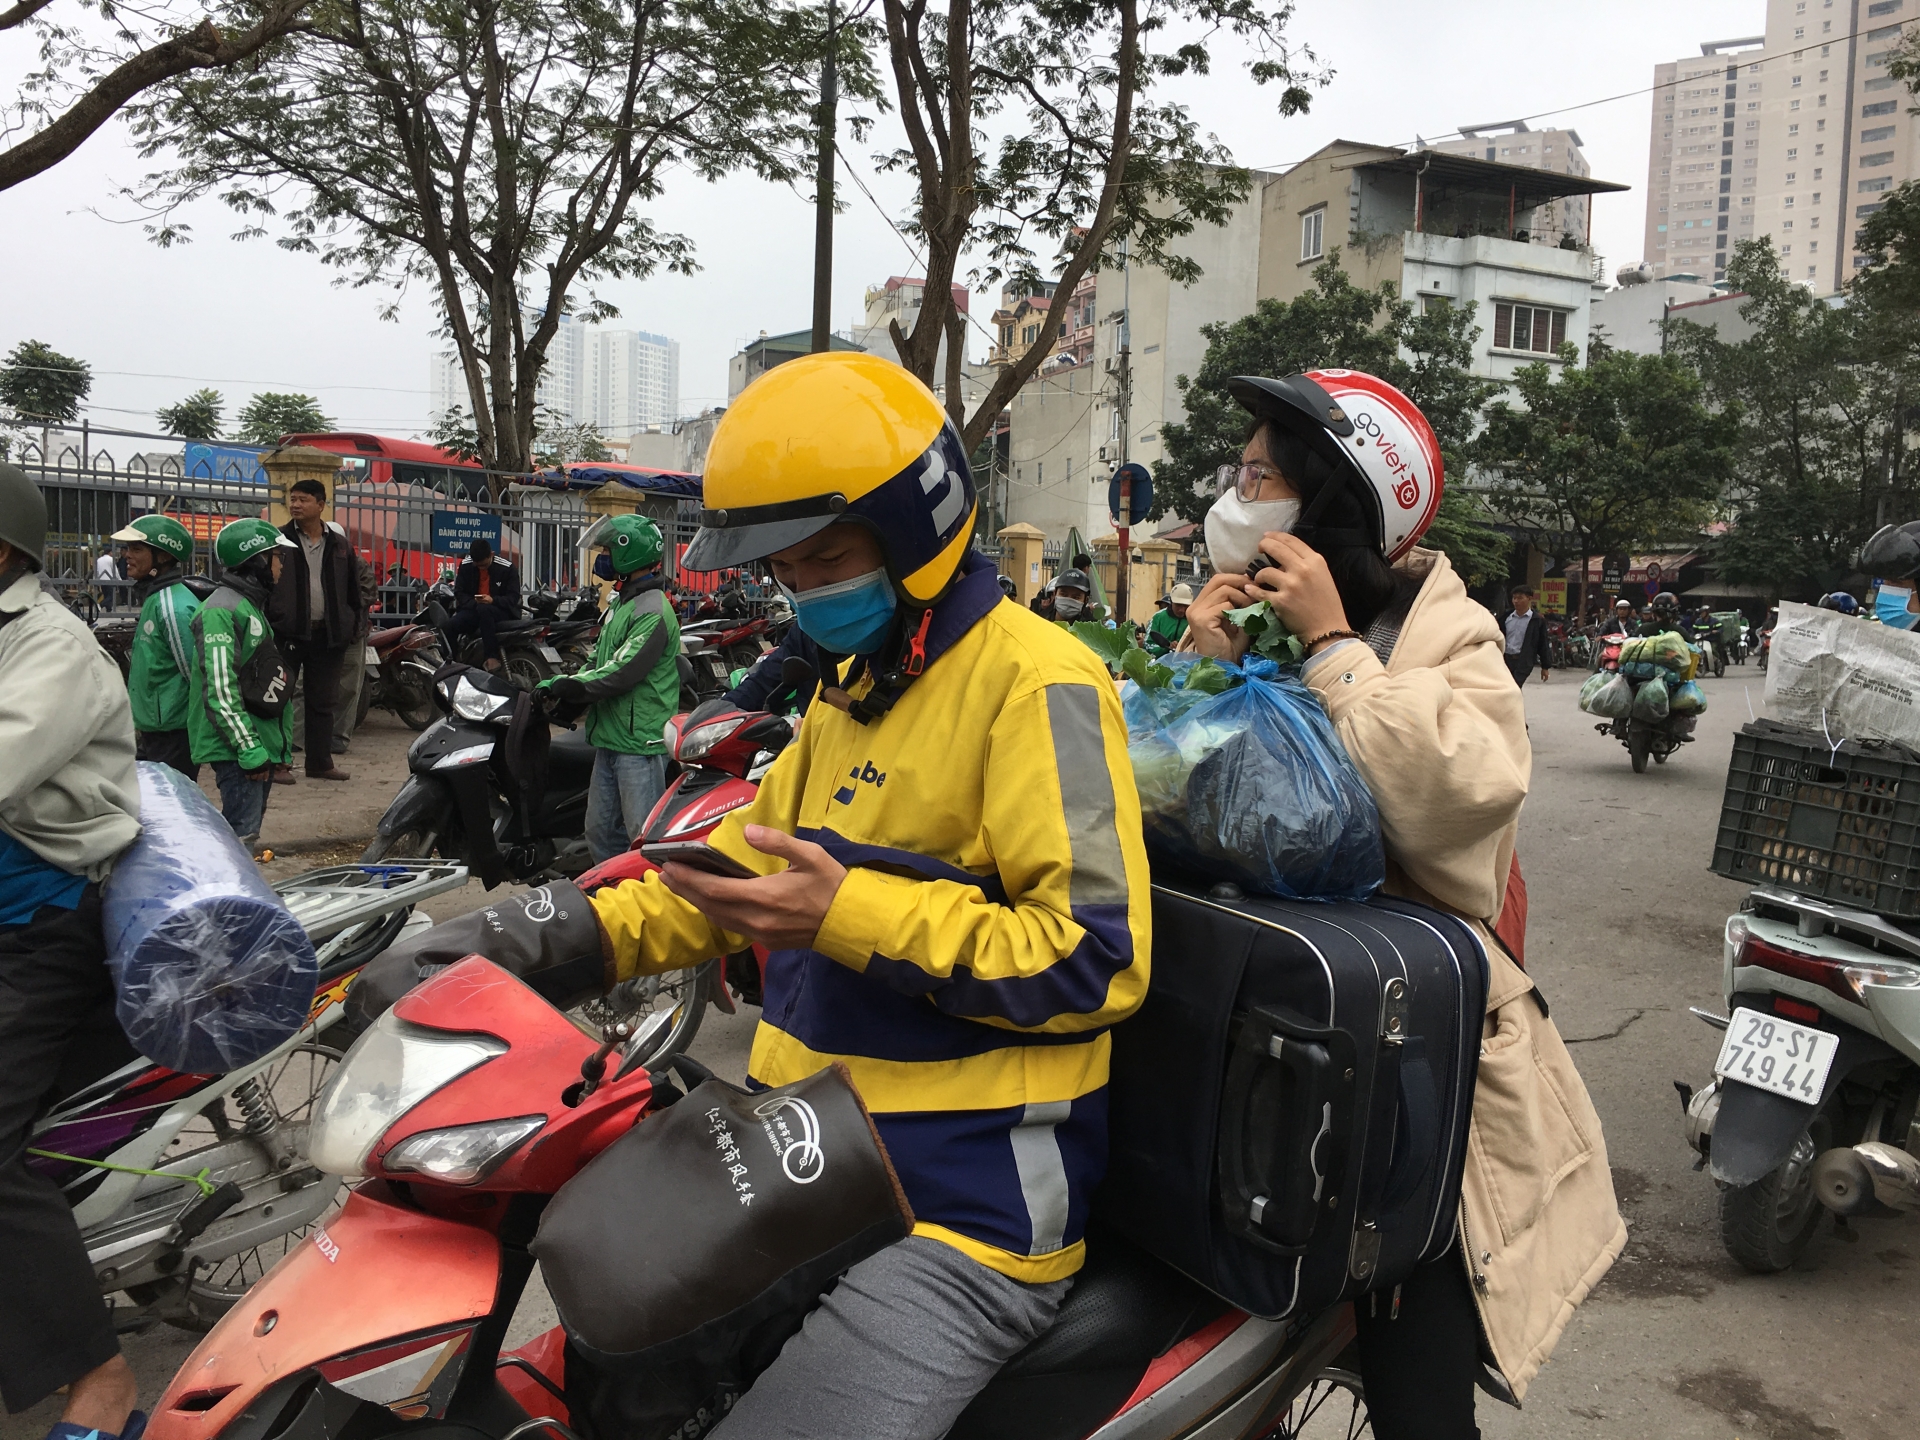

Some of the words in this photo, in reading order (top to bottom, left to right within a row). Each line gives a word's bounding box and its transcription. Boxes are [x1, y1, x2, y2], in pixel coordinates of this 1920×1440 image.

[455, 517, 468, 526] KHU
[438, 526, 457, 537] DÀNH
[458, 529, 471, 538] CHO
[472, 530, 481, 539] XE
[481, 530, 497, 539] MÁY
[157, 533, 184, 551] Grab
[238, 533, 267, 552] Grab
[1547, 593, 1559, 603] XE
[204, 632, 233, 644] Grab
[262, 665, 287, 703] FILA
[859, 760, 887, 788] be
[703, 796, 745, 819] JUPITER
[1775, 934, 1819, 949] HONDA
[1742, 1017, 1819, 1063] 29-S1
[1724, 1044, 1815, 1098] 749.44
